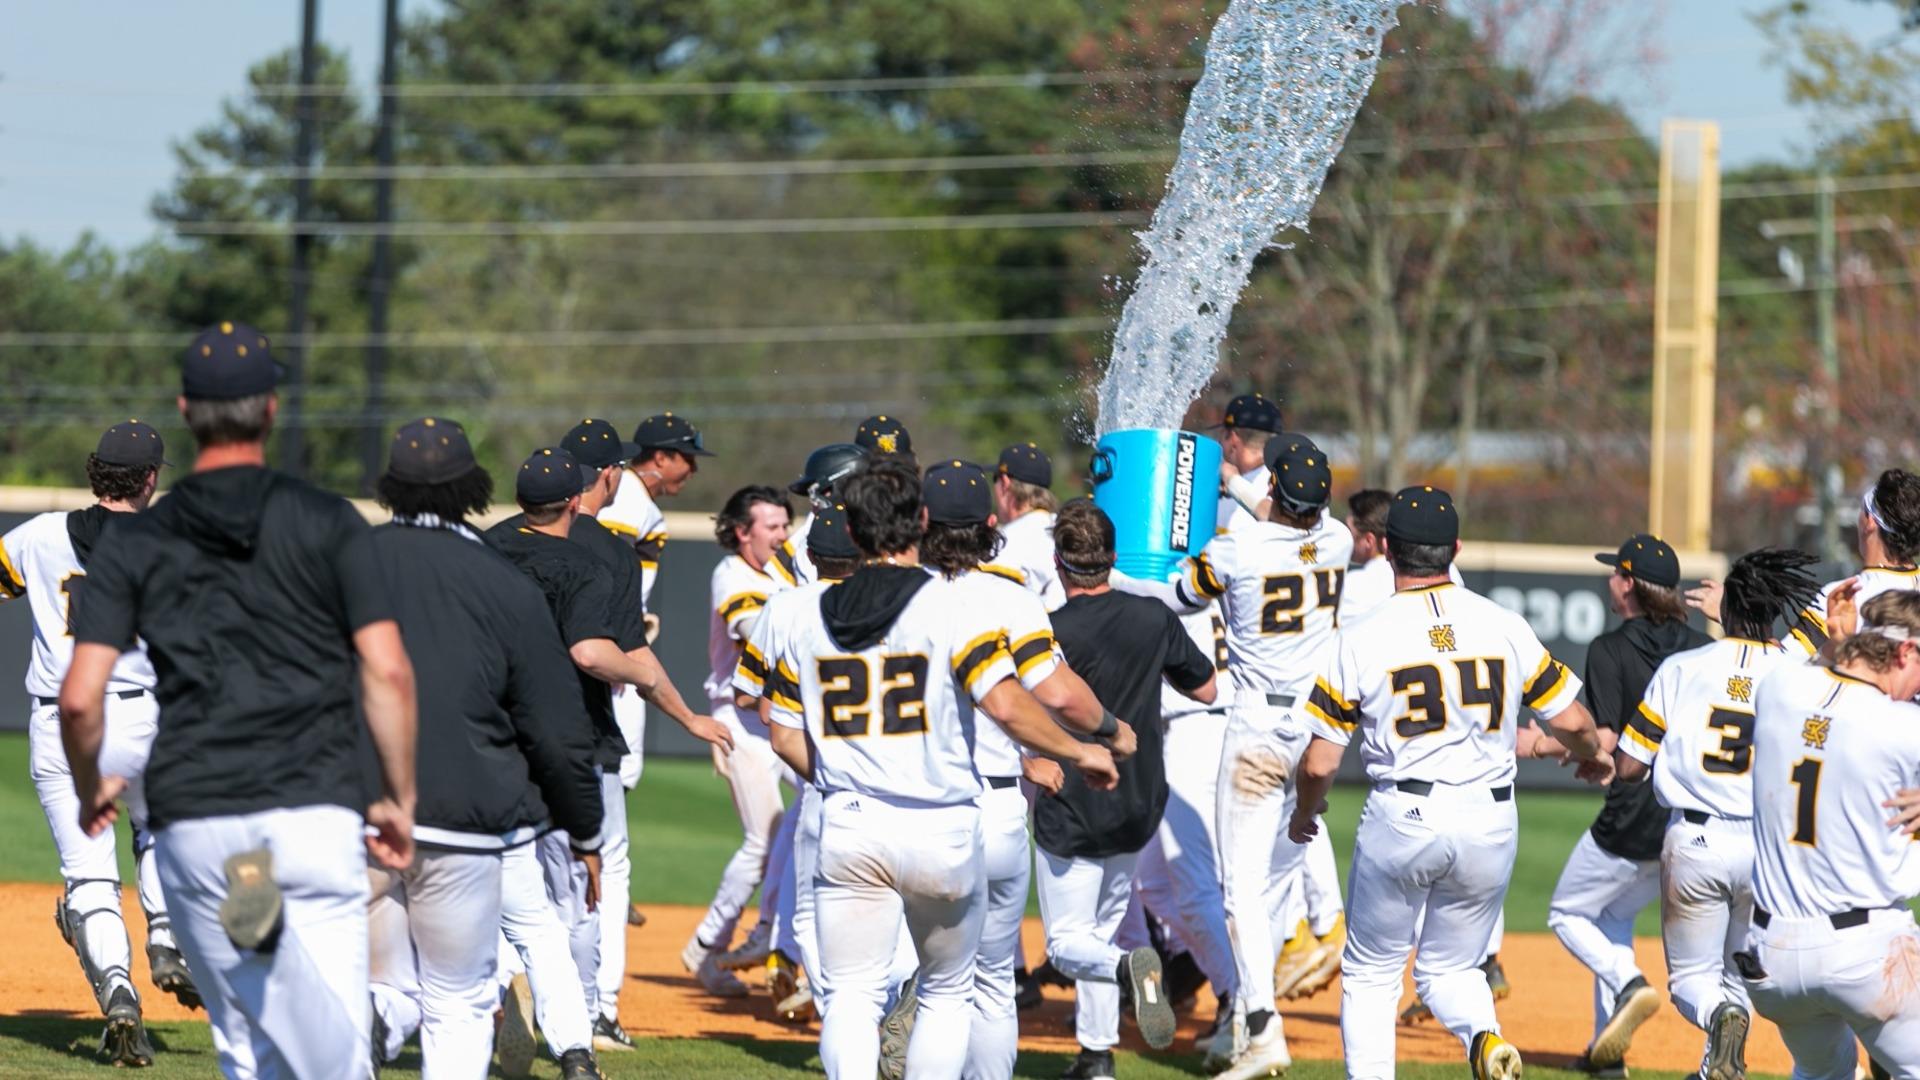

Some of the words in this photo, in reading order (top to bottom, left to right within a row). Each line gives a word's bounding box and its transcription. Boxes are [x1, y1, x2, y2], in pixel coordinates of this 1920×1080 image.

[1171, 438, 1196, 549] POWERADE
[1261, 566, 1344, 637] 24
[815, 652, 931, 739] 22
[1387, 656, 1506, 741] 34
[1702, 704, 1756, 777] 3
[1788, 755, 1824, 849] 1
